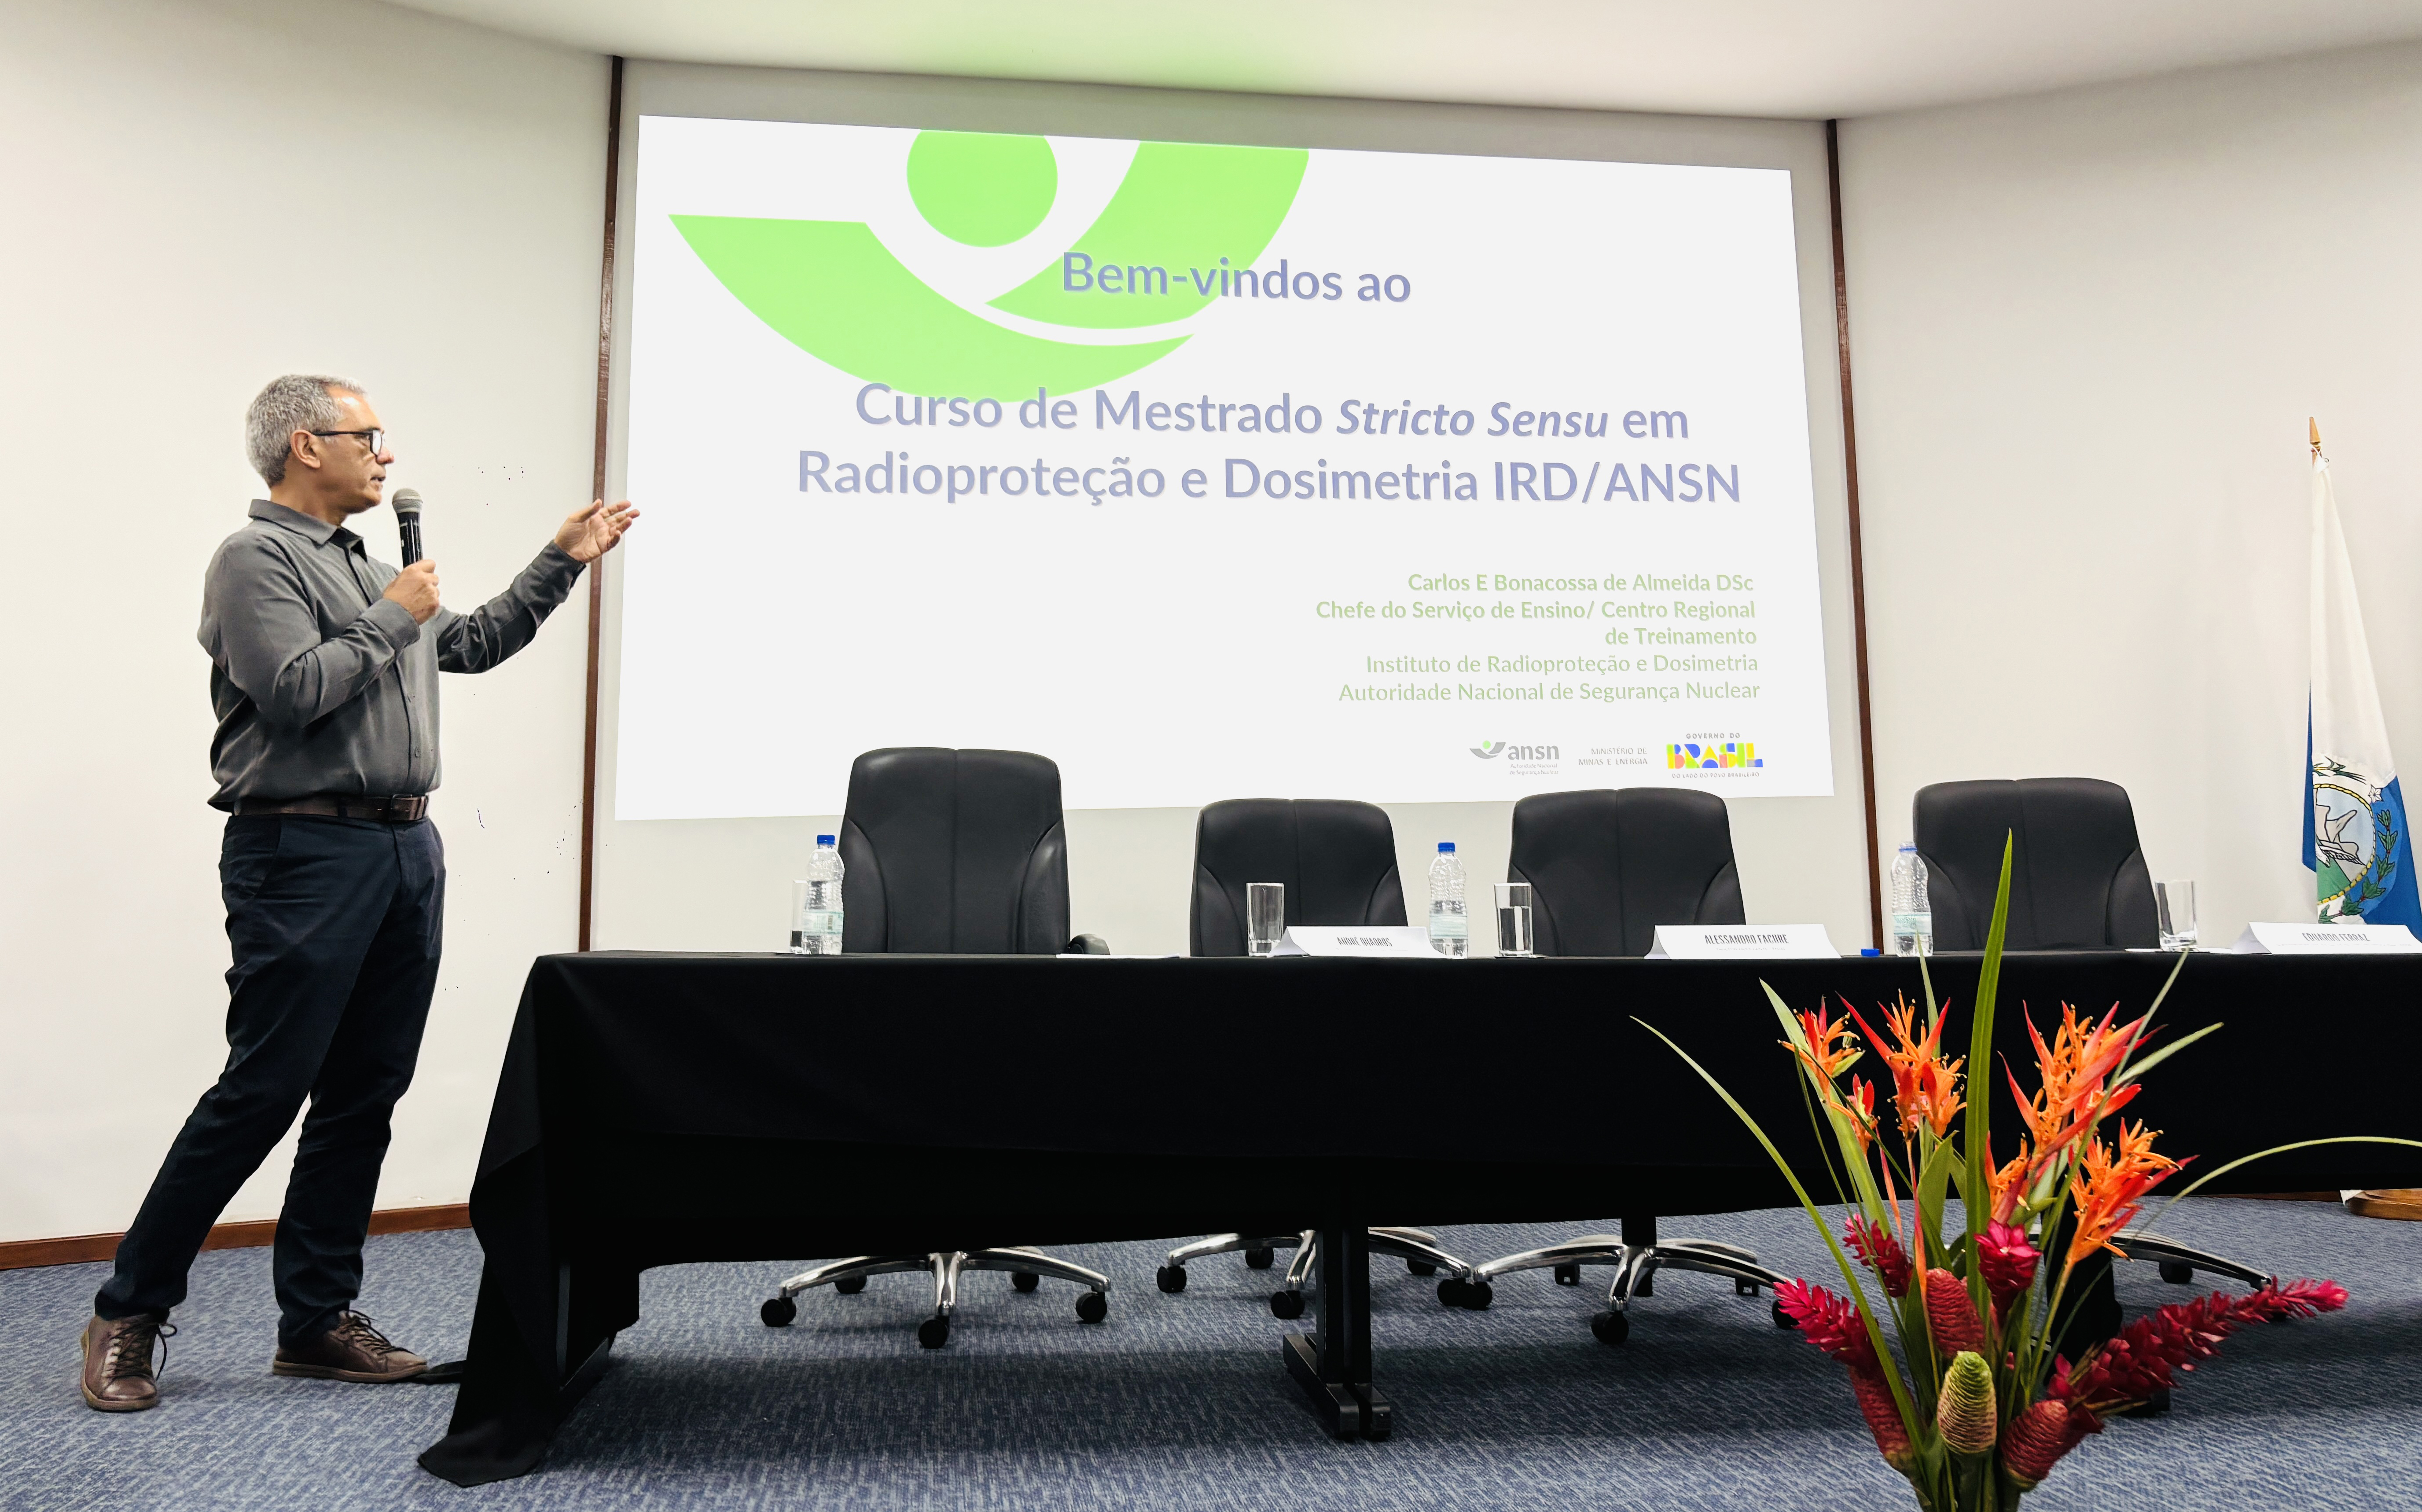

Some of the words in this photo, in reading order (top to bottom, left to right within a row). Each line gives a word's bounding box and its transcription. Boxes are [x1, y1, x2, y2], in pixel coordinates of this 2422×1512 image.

[1064, 252, 1343, 300] Bem-vindos
[1356, 273, 1411, 303] ao
[856, 383, 1002, 427] Curso
[1018, 388, 1077, 429] de
[1095, 389, 1322, 434] Mestrado
[1336, 399, 1474, 436] Stricto
[1487, 402, 1608, 438] Sensu
[1622, 410, 1688, 439] em
[799, 450, 1165, 506] Radioproteção
[1181, 469, 1206, 497] e
[1224, 458, 1477, 501] Dosimetria
[1494, 461, 1739, 503] IRD/ANSN
[1408, 573, 1470, 591] Carlos
[1477, 574, 1488, 591] E
[1495, 575, 1598, 591] Bonacossa
[1604, 573, 1627, 591] de
[1632, 574, 1710, 591] Almeida
[1716, 575, 1753, 591] DSc
[1316, 601, 1375, 619] Chefe
[1382, 601, 1407, 619] do
[1413, 601, 1485, 622] Serviço
[1491, 601, 1515, 619] de
[1522, 601, 1595, 620] Ensino/
[1602, 602, 1668, 618] Centro
[1674, 601, 1755, 621] Regional
[1606, 628, 1629, 645] de
[1634, 627, 1757, 645] Treinamento
[1367, 656, 1451, 673] Instituto
[1457, 655, 1481, 672] de
[1488, 655, 1630, 676] Radioproteção
[1637, 660, 1647, 672] e
[1654, 654, 1757, 671] Dosimetria
[1339, 683, 1451, 701] Autoridade
[1459, 683, 1544, 701] Nacional
[1551, 683, 1573, 700] de
[1580, 683, 1680, 703] Segurança
[1687, 682, 1760, 699] Nuclear
[1508, 745, 1559, 760] ansn
[1591, 746, 1633, 755] MINISTÉRIO
[1666, 743, 1763, 769] BRASIL
[1337, 935, 1361, 946] ANDRÉ
[1705, 935, 1757, 944] ALESSANDRO
[1757, 934, 1790, 944] FACURE
[2301, 932, 2339, 941] EDUARDO
[2338, 933, 2371, 941] FERRAZ
